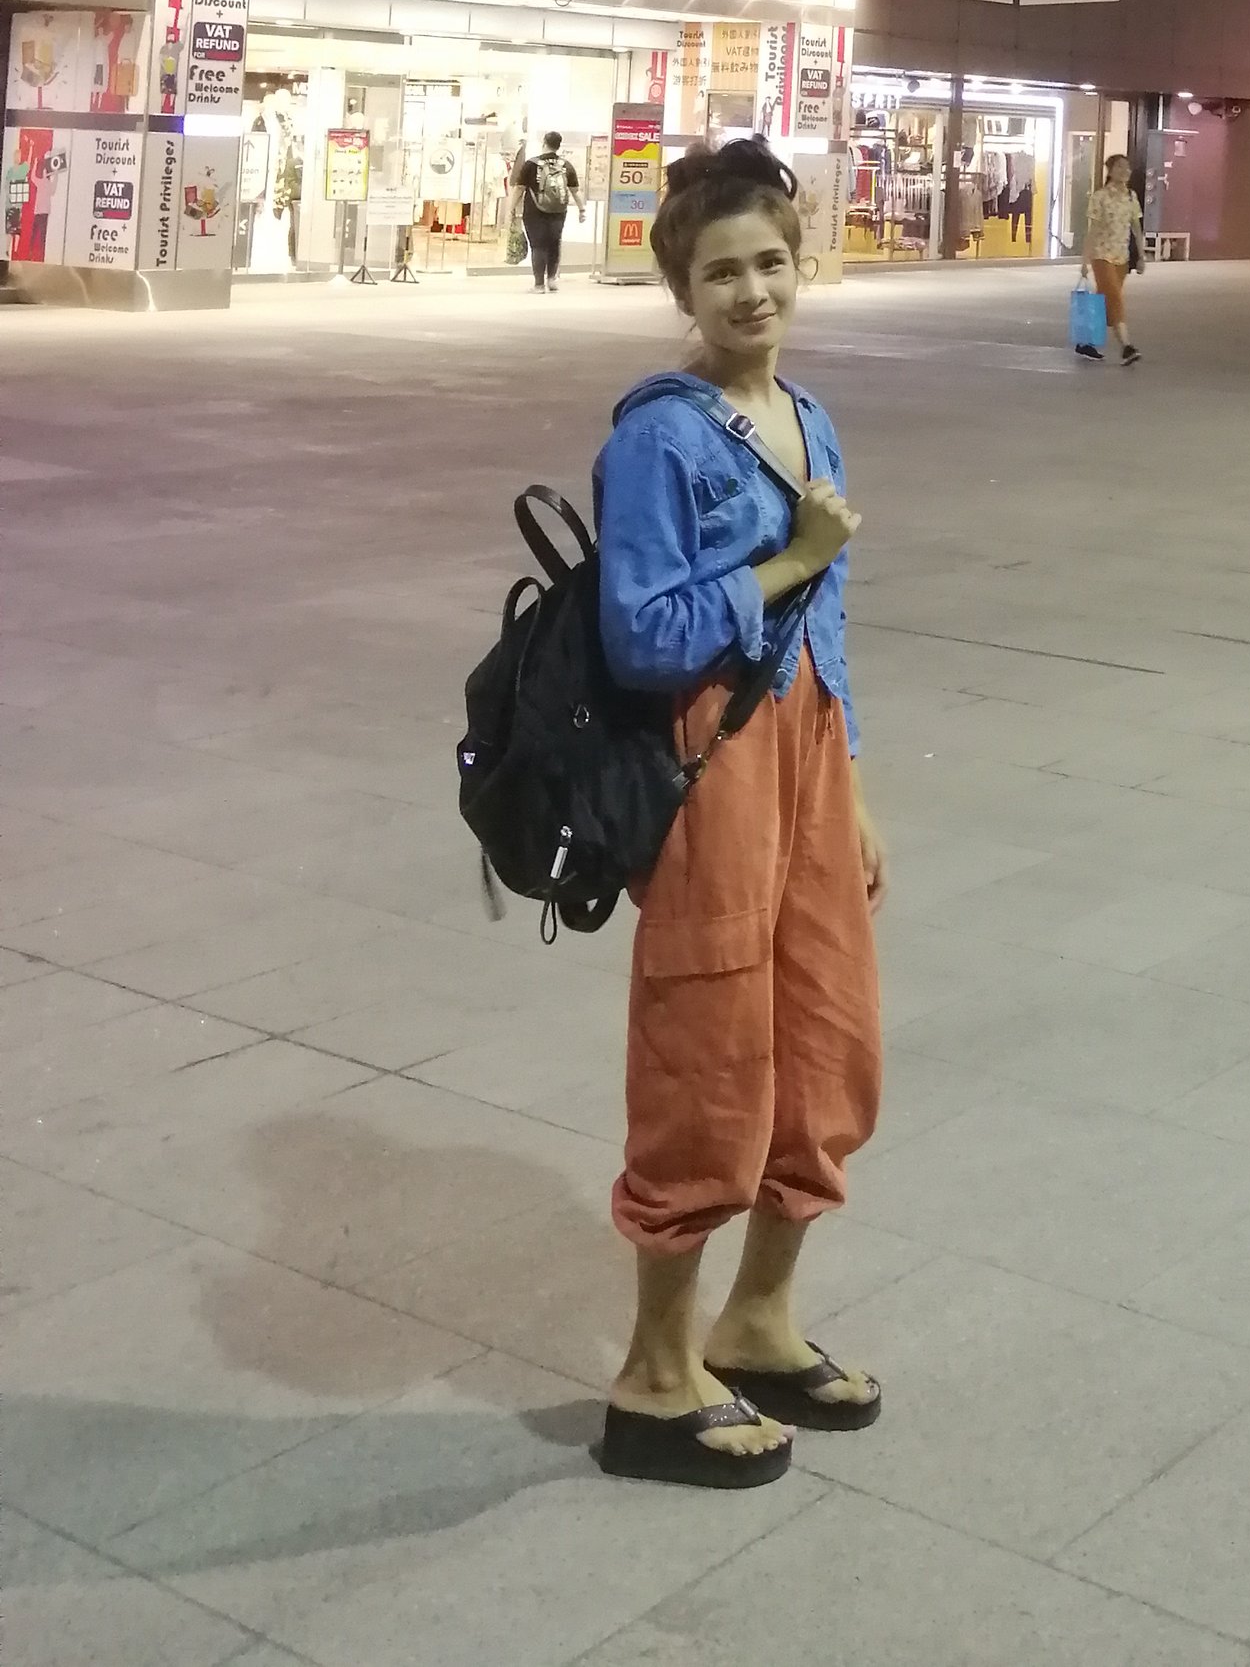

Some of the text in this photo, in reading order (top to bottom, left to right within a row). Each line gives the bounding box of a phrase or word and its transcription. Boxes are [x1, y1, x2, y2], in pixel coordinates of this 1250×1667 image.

[205, 24, 233, 39] VAT
[195, 37, 240, 51] REFUND
[801, 36, 827, 48] Tourist
[765, 25, 779, 82] Tourist
[801, 47, 832, 59] Discount
[189, 64, 226, 82] Free
[806, 69, 823, 81] VAT
[194, 82, 240, 95] Welcome
[801, 80, 828, 90] REFUND
[188, 92, 221, 104] Drinks
[798, 100, 819, 113] Free
[801, 114, 828, 122] Welcome
[797, 121, 817, 130] Drinks
[638, 132, 661, 142] SALE
[95, 137, 130, 151] Tourist
[95, 153, 136, 166] Discount
[103, 182, 125, 196] VAT
[95, 196, 130, 209] REFUND
[156, 140, 177, 267] Tourist Privileges
[829, 158, 843, 252] Tourist Privileges
[90, 224, 119, 241] Free
[93, 242, 129, 254] Welcome
[88, 252, 114, 264] Drinks
